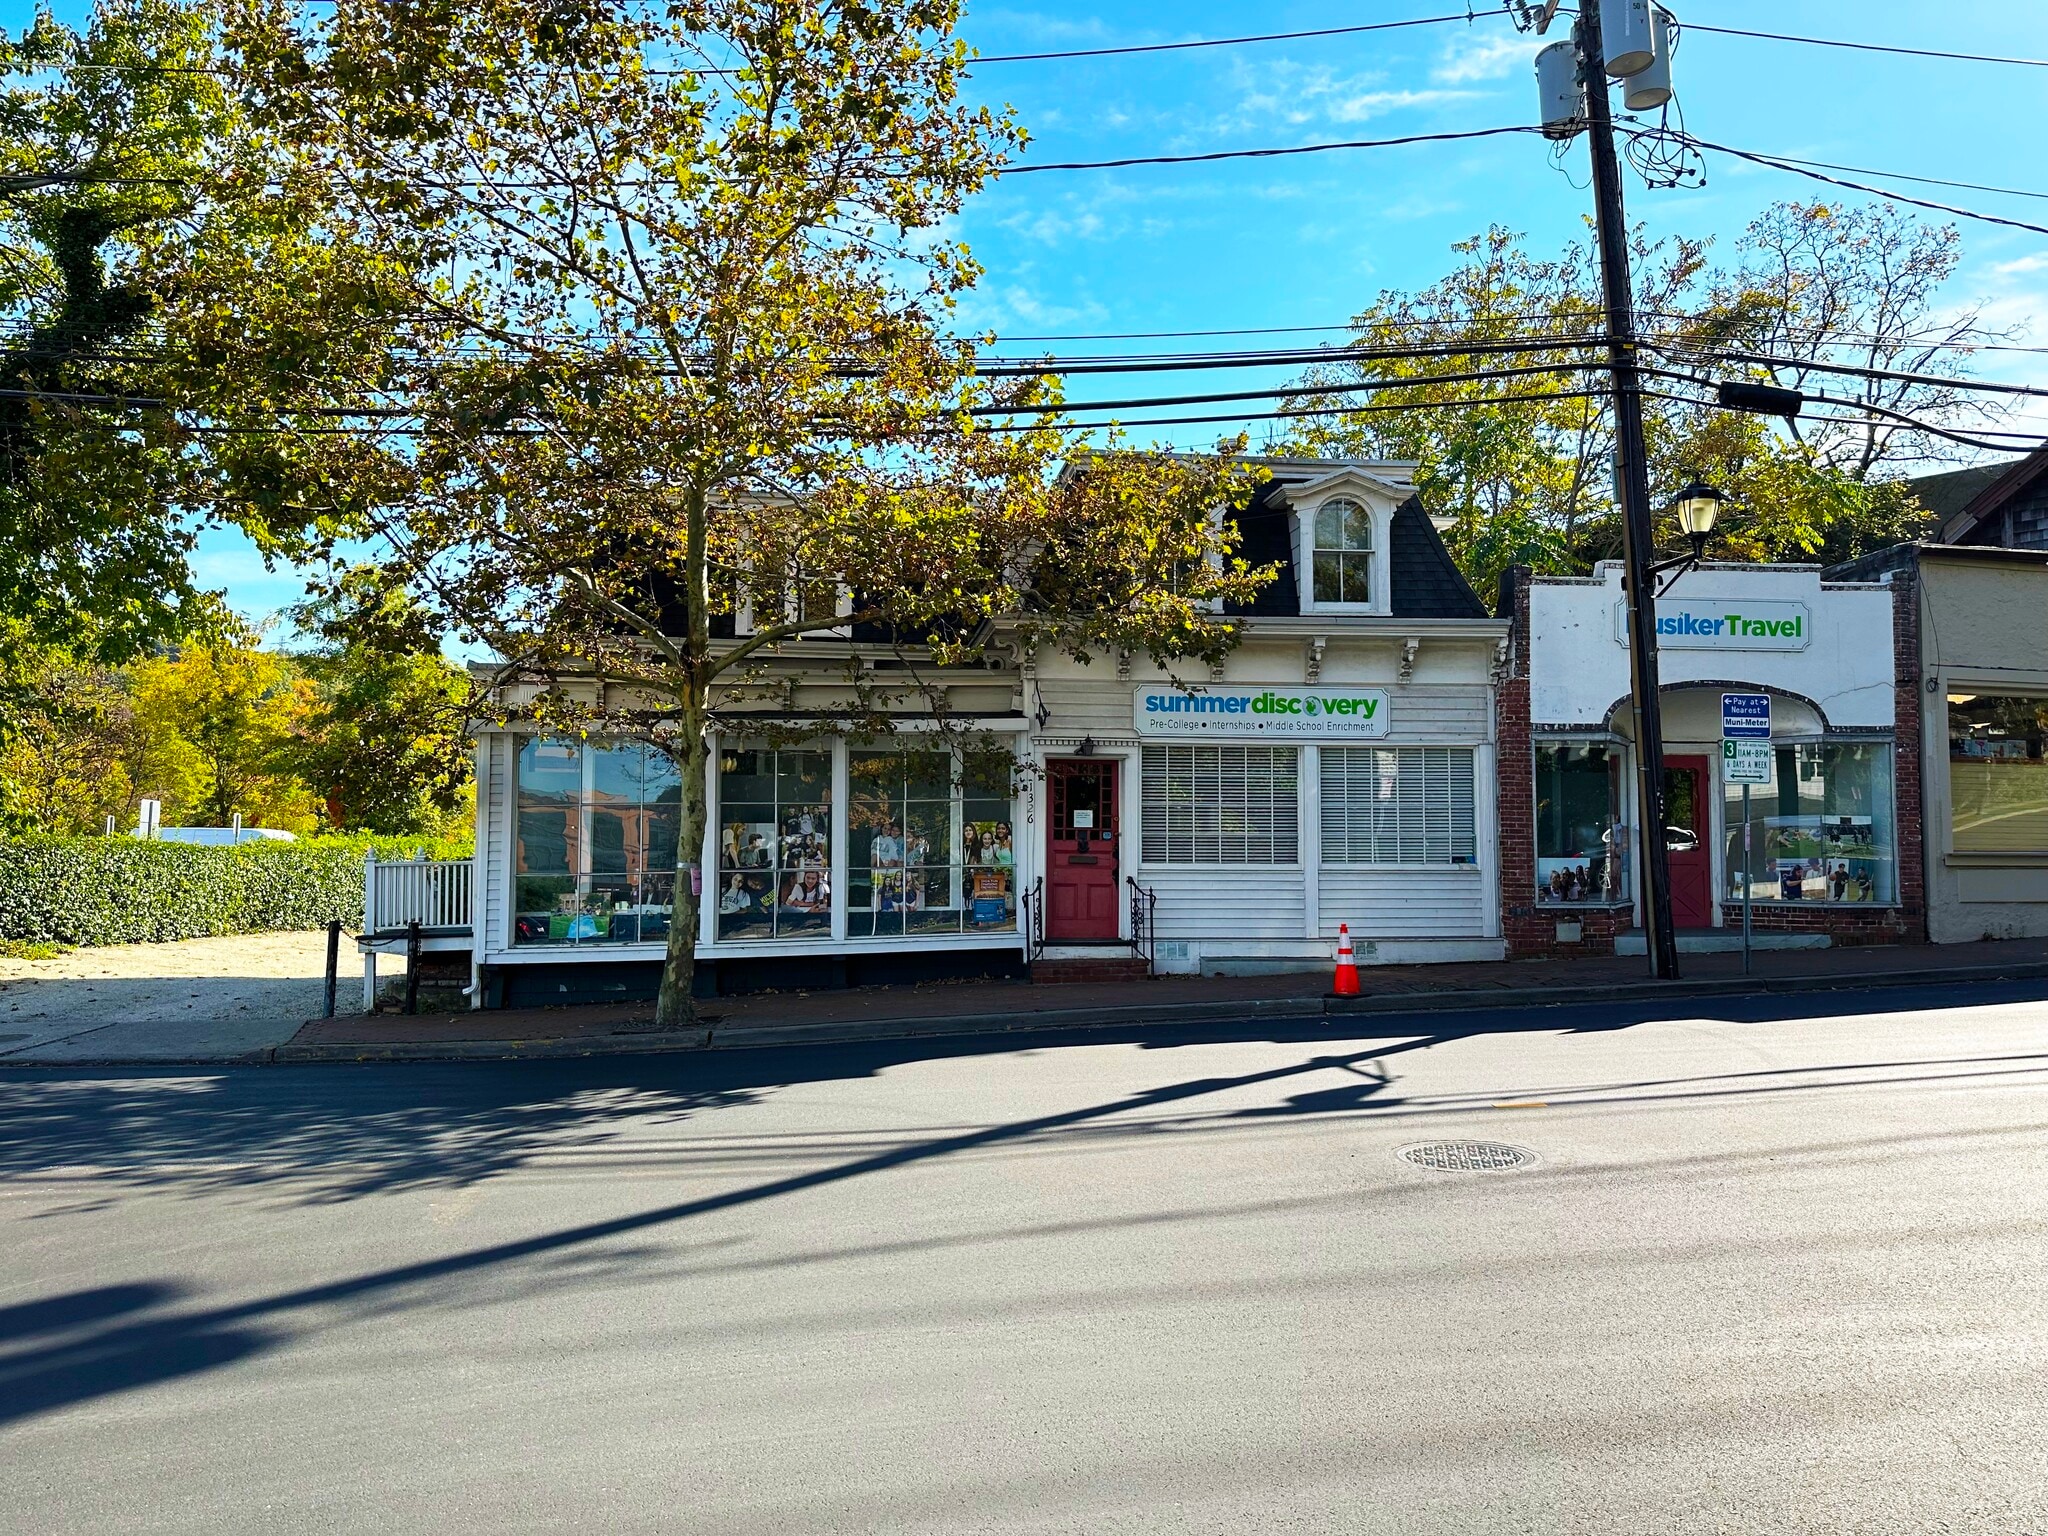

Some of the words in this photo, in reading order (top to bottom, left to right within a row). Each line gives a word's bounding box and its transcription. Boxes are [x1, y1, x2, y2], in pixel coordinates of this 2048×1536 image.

[1632, 2, 1641, 10] 50
[1626, 612, 1802, 638] usikerTravel
[1733, 697, 1746, 706] Pay
[1731, 706, 1761, 714] Nearest
[1150, 719, 1199, 730] Pre-College
[1209, 721, 1256, 731] Internships
[1266, 721, 1294, 731] Middle
[1296, 721, 1325, 731] School
[1327, 721, 1374, 732] Enrichment
[1725, 718, 1768, 727] Muni-Meter
[1726, 742, 1734, 756] 3
[1737, 749, 1769, 758] 11AM-8PM
[1733, 760, 1745, 769] DAYS
[1748, 761, 1752, 769] A
[1754, 761, 1768, 769] WEEK
